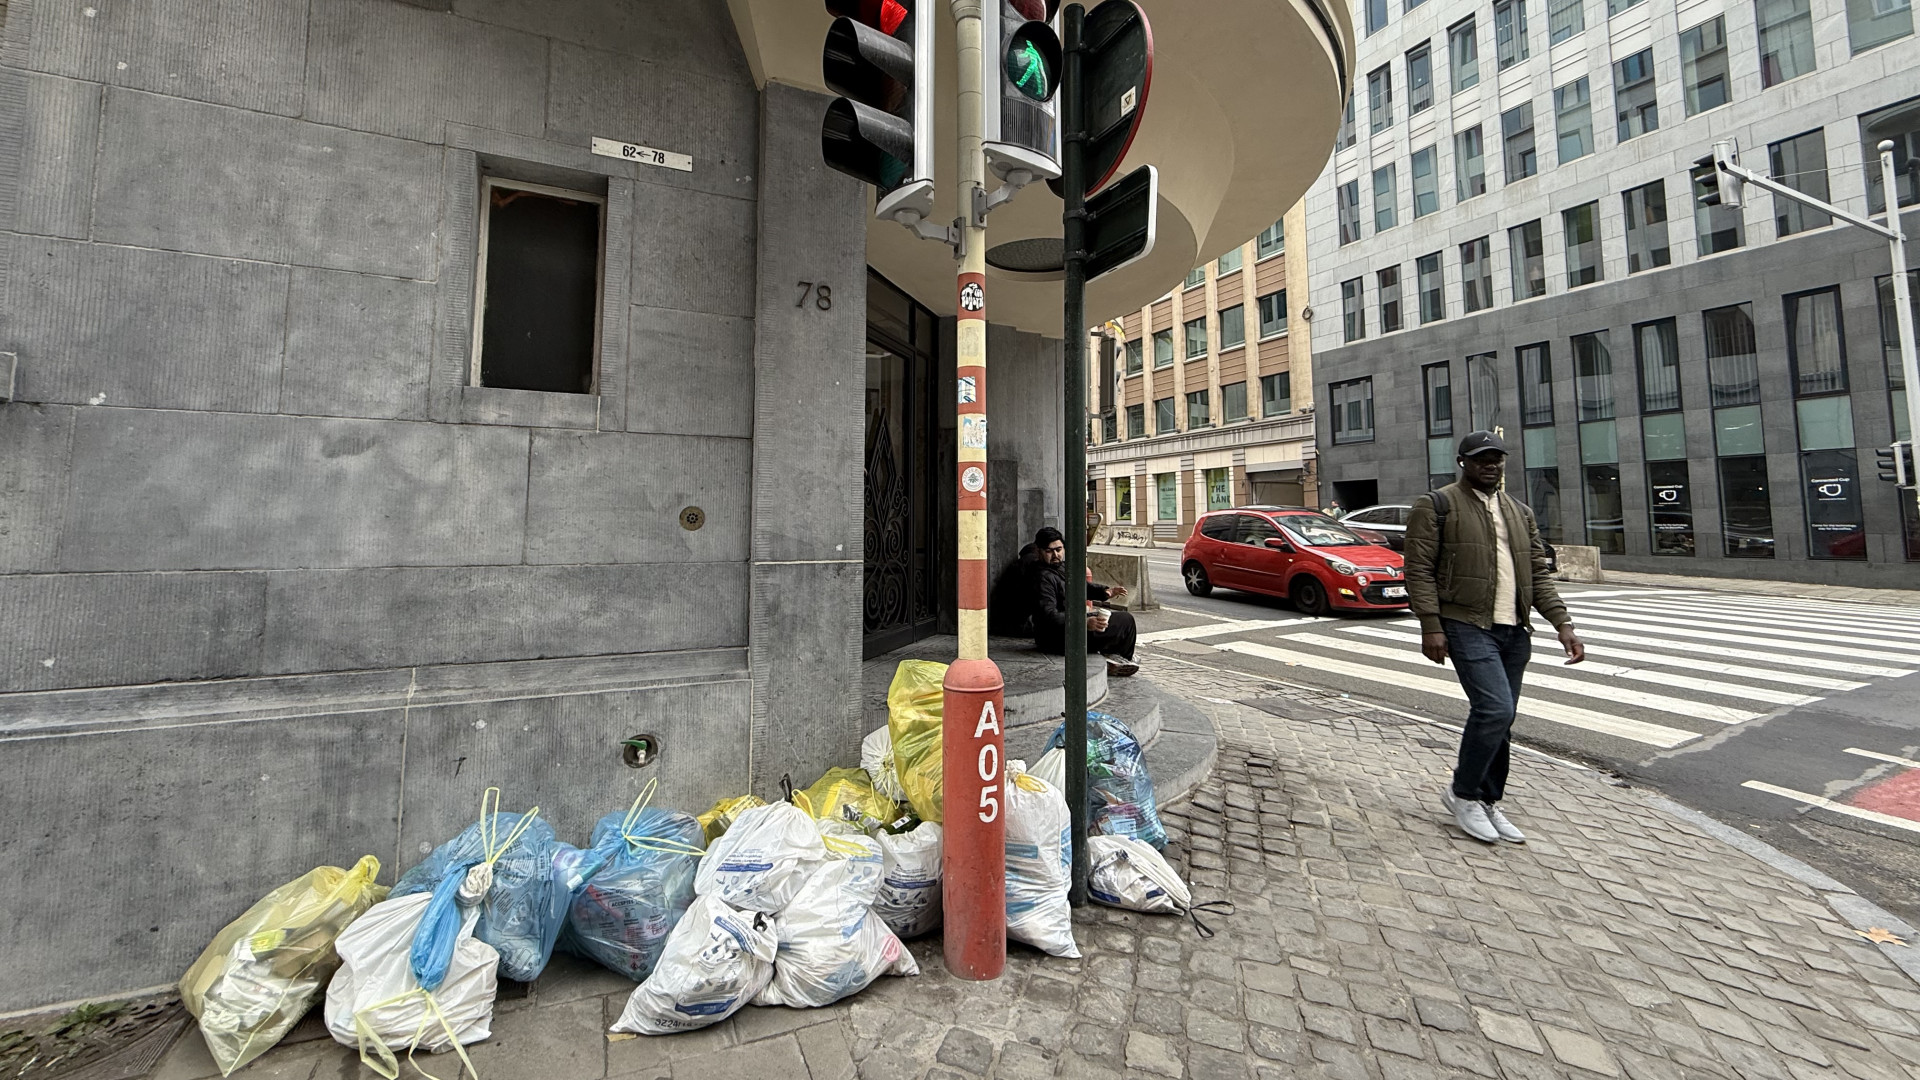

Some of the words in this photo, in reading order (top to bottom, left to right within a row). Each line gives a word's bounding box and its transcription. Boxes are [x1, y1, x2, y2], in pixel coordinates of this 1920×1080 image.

[622, 145, 636, 158] 62
[651, 151, 665, 164] 78
[796, 281, 832, 311] 78
[1210, 485, 1226, 493] THE
